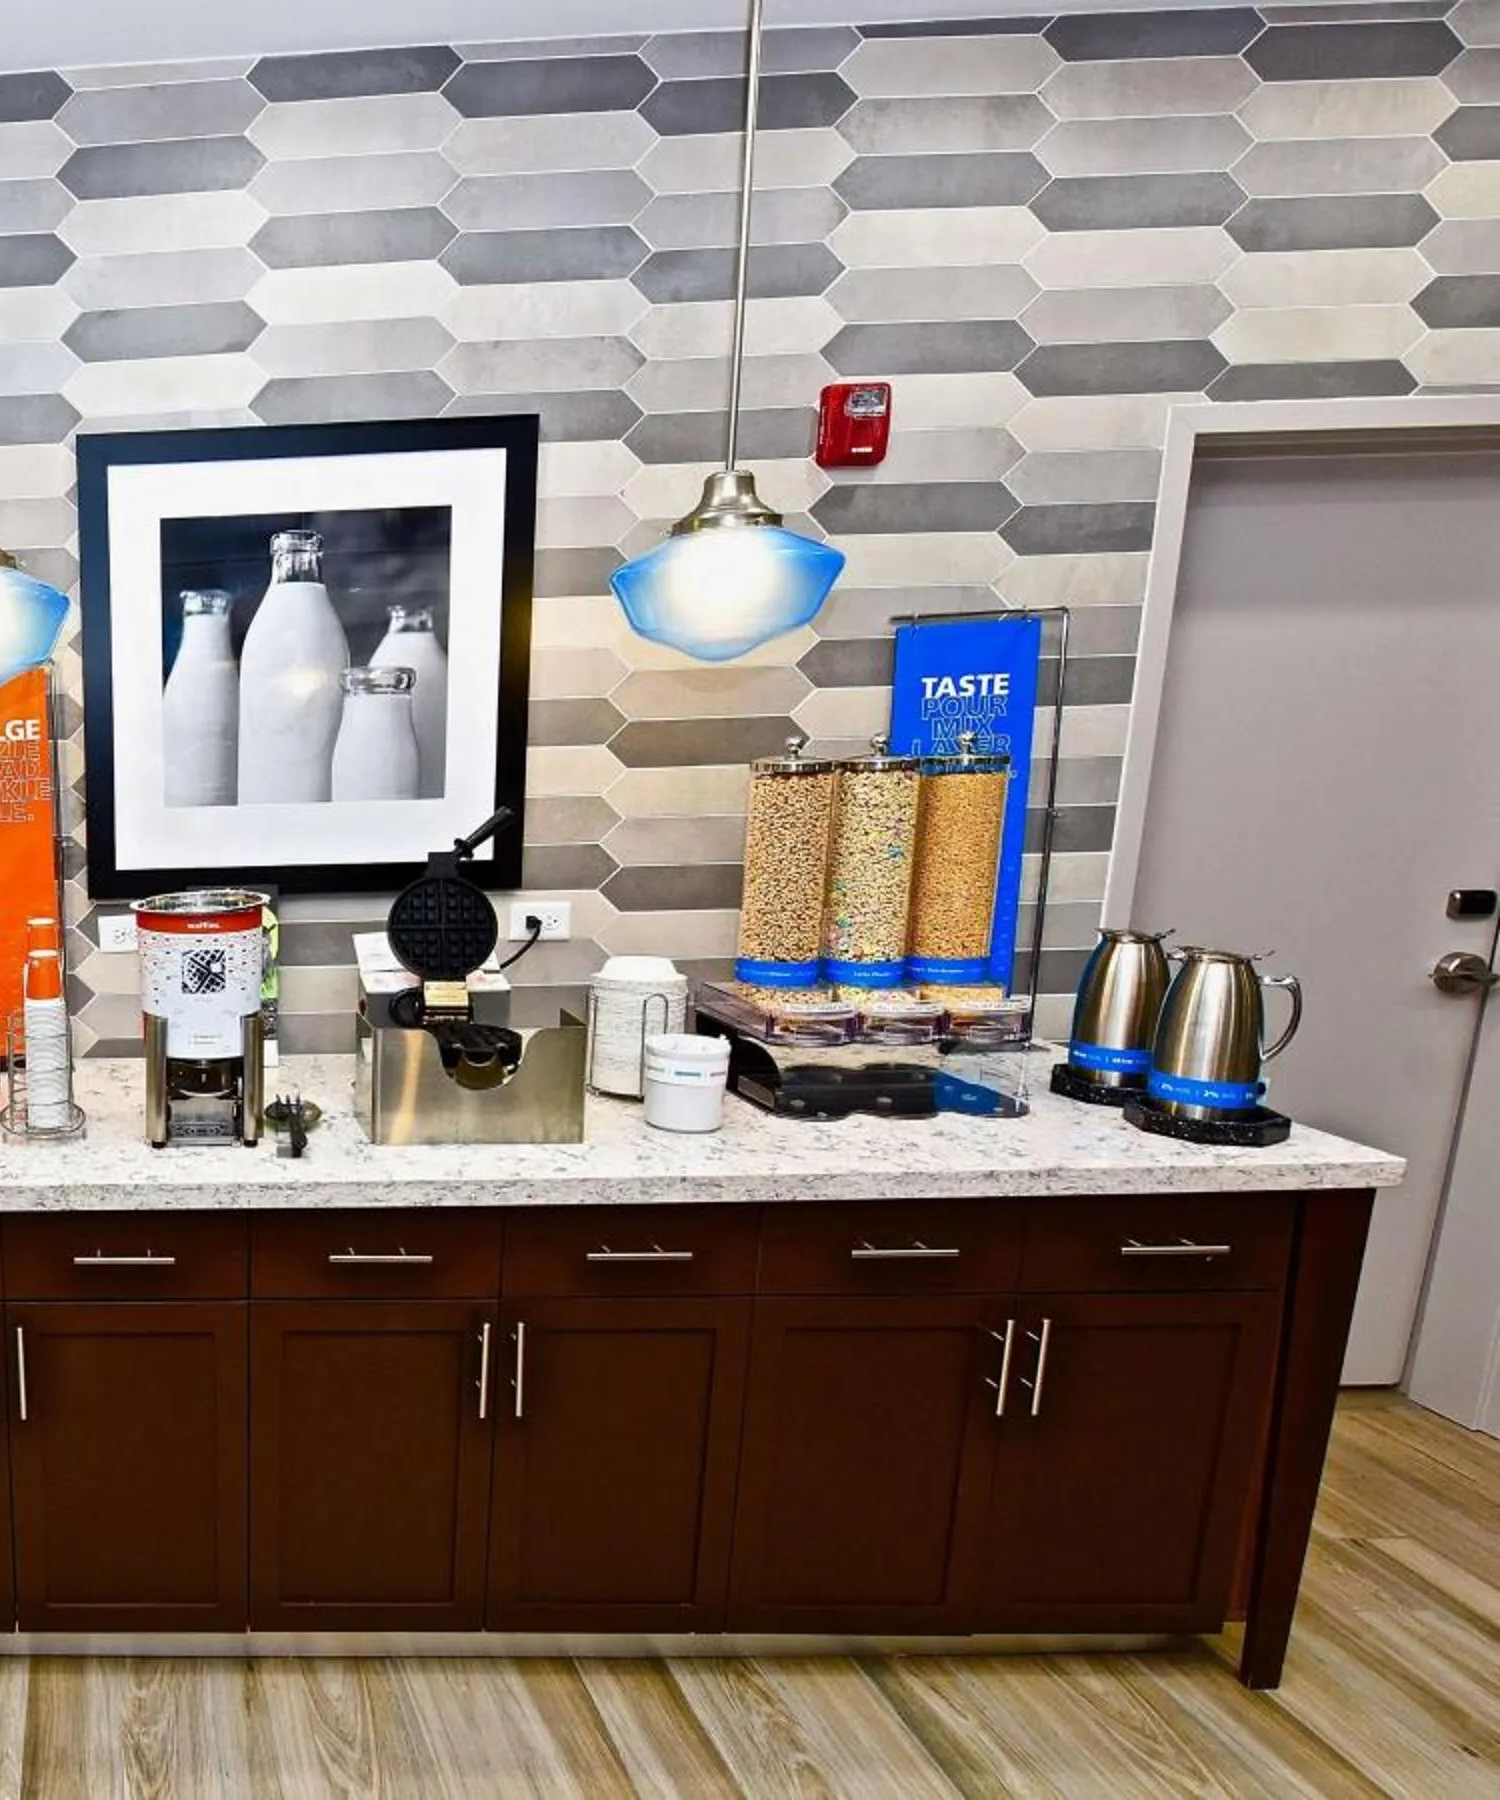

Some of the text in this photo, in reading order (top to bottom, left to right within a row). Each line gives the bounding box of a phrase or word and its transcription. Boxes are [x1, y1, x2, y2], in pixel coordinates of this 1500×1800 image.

[921, 673, 1010, 699] TASTE
[921, 694, 1008, 720] POUR
[932, 713, 994, 741] MIX
